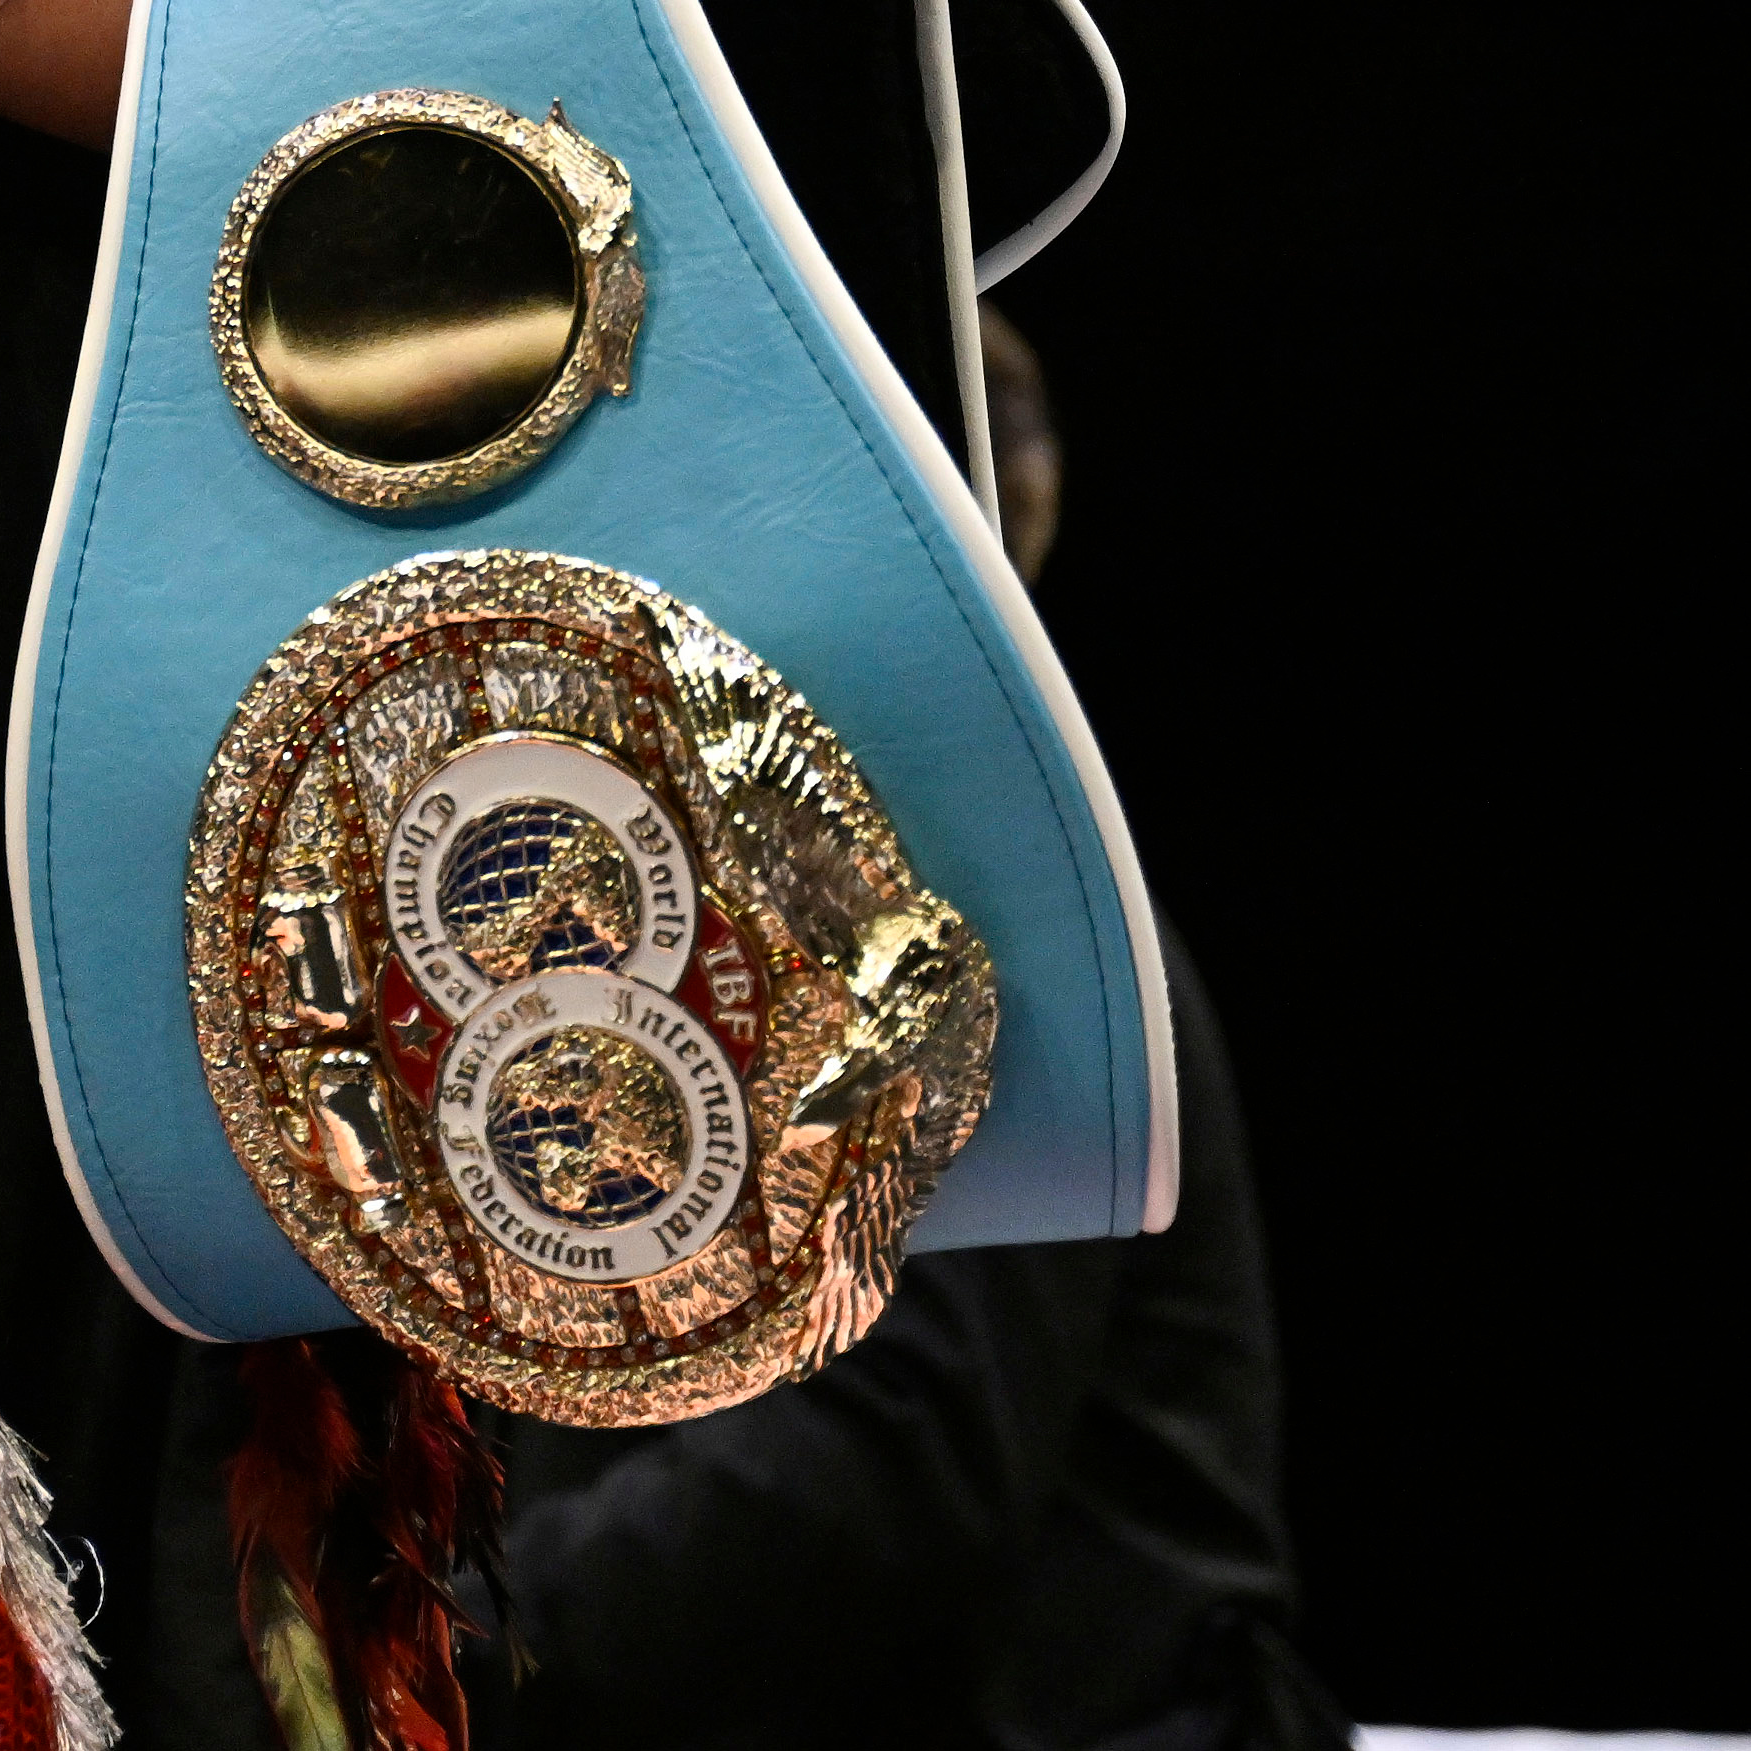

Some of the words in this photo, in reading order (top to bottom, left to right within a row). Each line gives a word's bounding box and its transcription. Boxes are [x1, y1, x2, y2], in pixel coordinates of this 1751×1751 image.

[393, 792, 477, 1008] Champion
[625, 804, 686, 950] World
[447, 986, 557, 1110] Boxing
[701, 938, 759, 1043] IBF
[443, 1120, 616, 1271] Federation
[604, 987, 741, 1260] International
